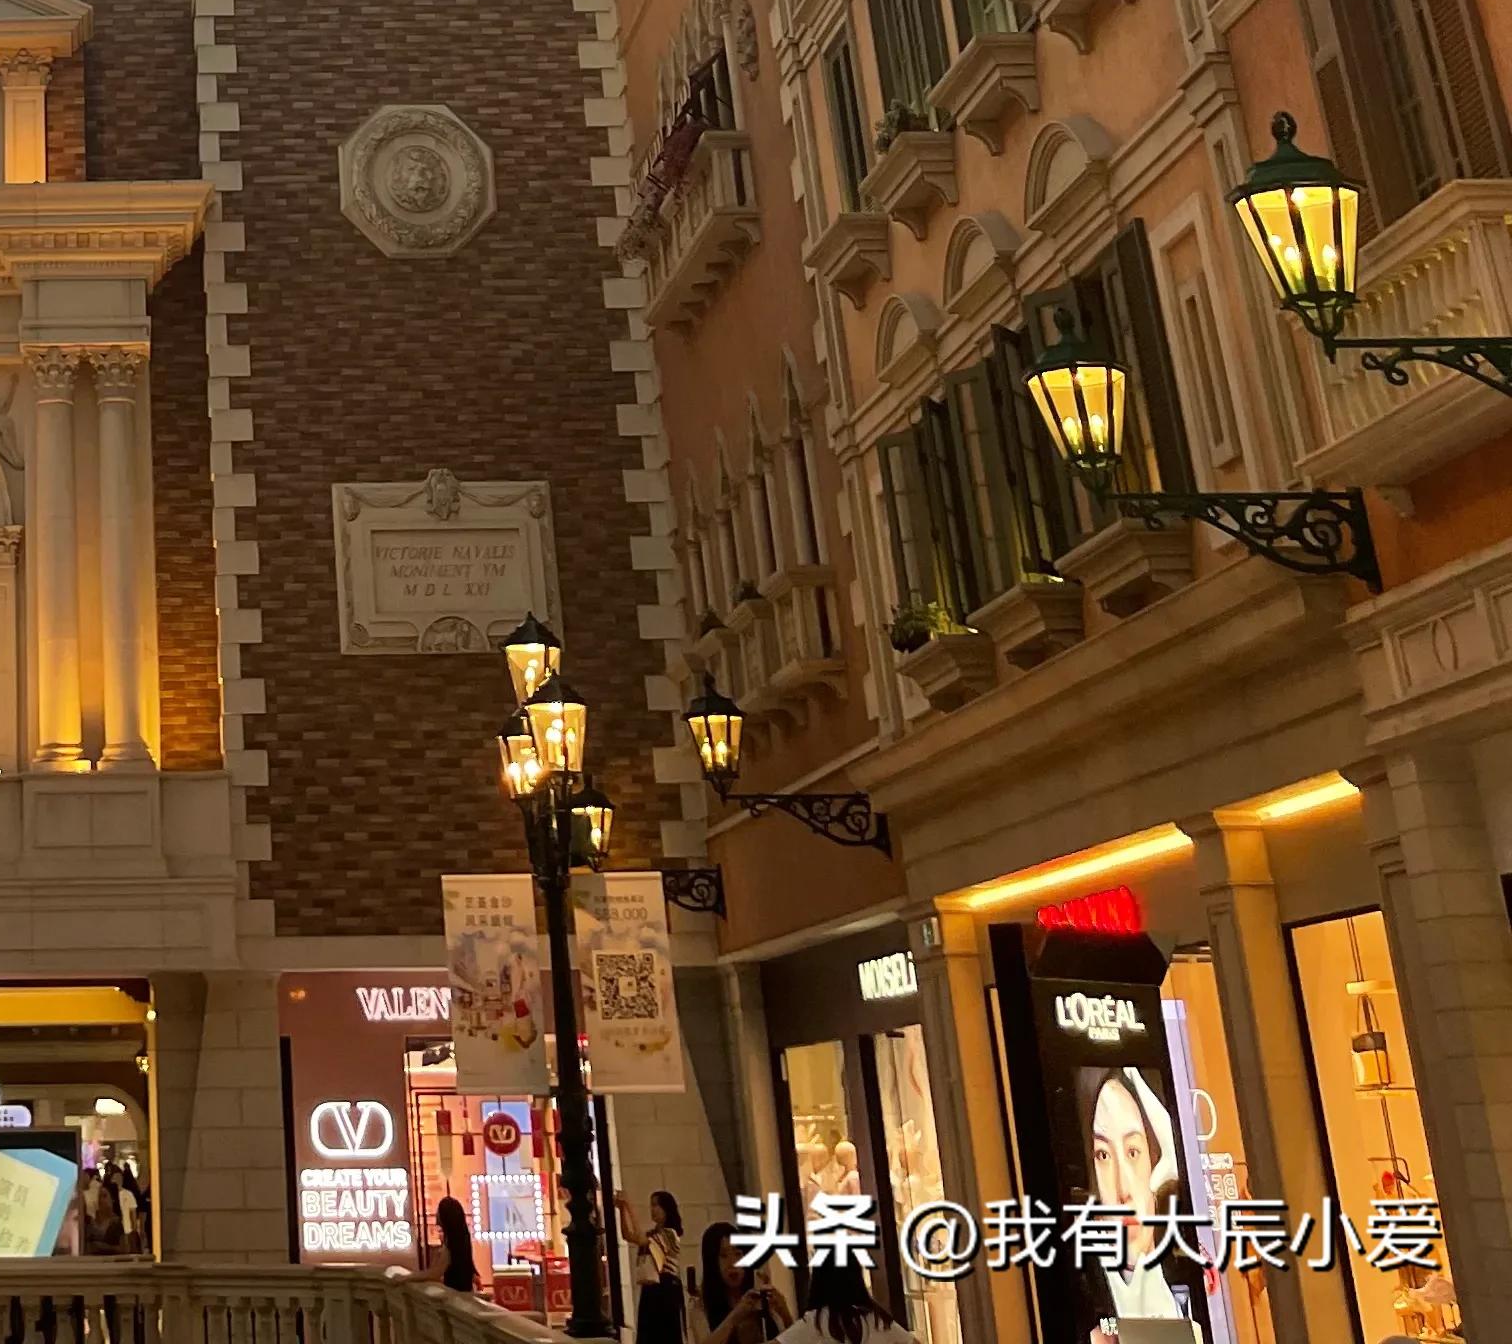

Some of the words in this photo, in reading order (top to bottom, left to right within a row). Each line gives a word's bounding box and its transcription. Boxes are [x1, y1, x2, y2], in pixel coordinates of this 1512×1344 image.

[1056, 992, 1145, 1030] L'ORÉAL
[301, 1169, 361, 1187] CREATE
[362, 1169, 408, 1187] YOUR
[301, 1190, 409, 1218] BEAUTY
[303, 1220, 412, 1251] DREAMS
